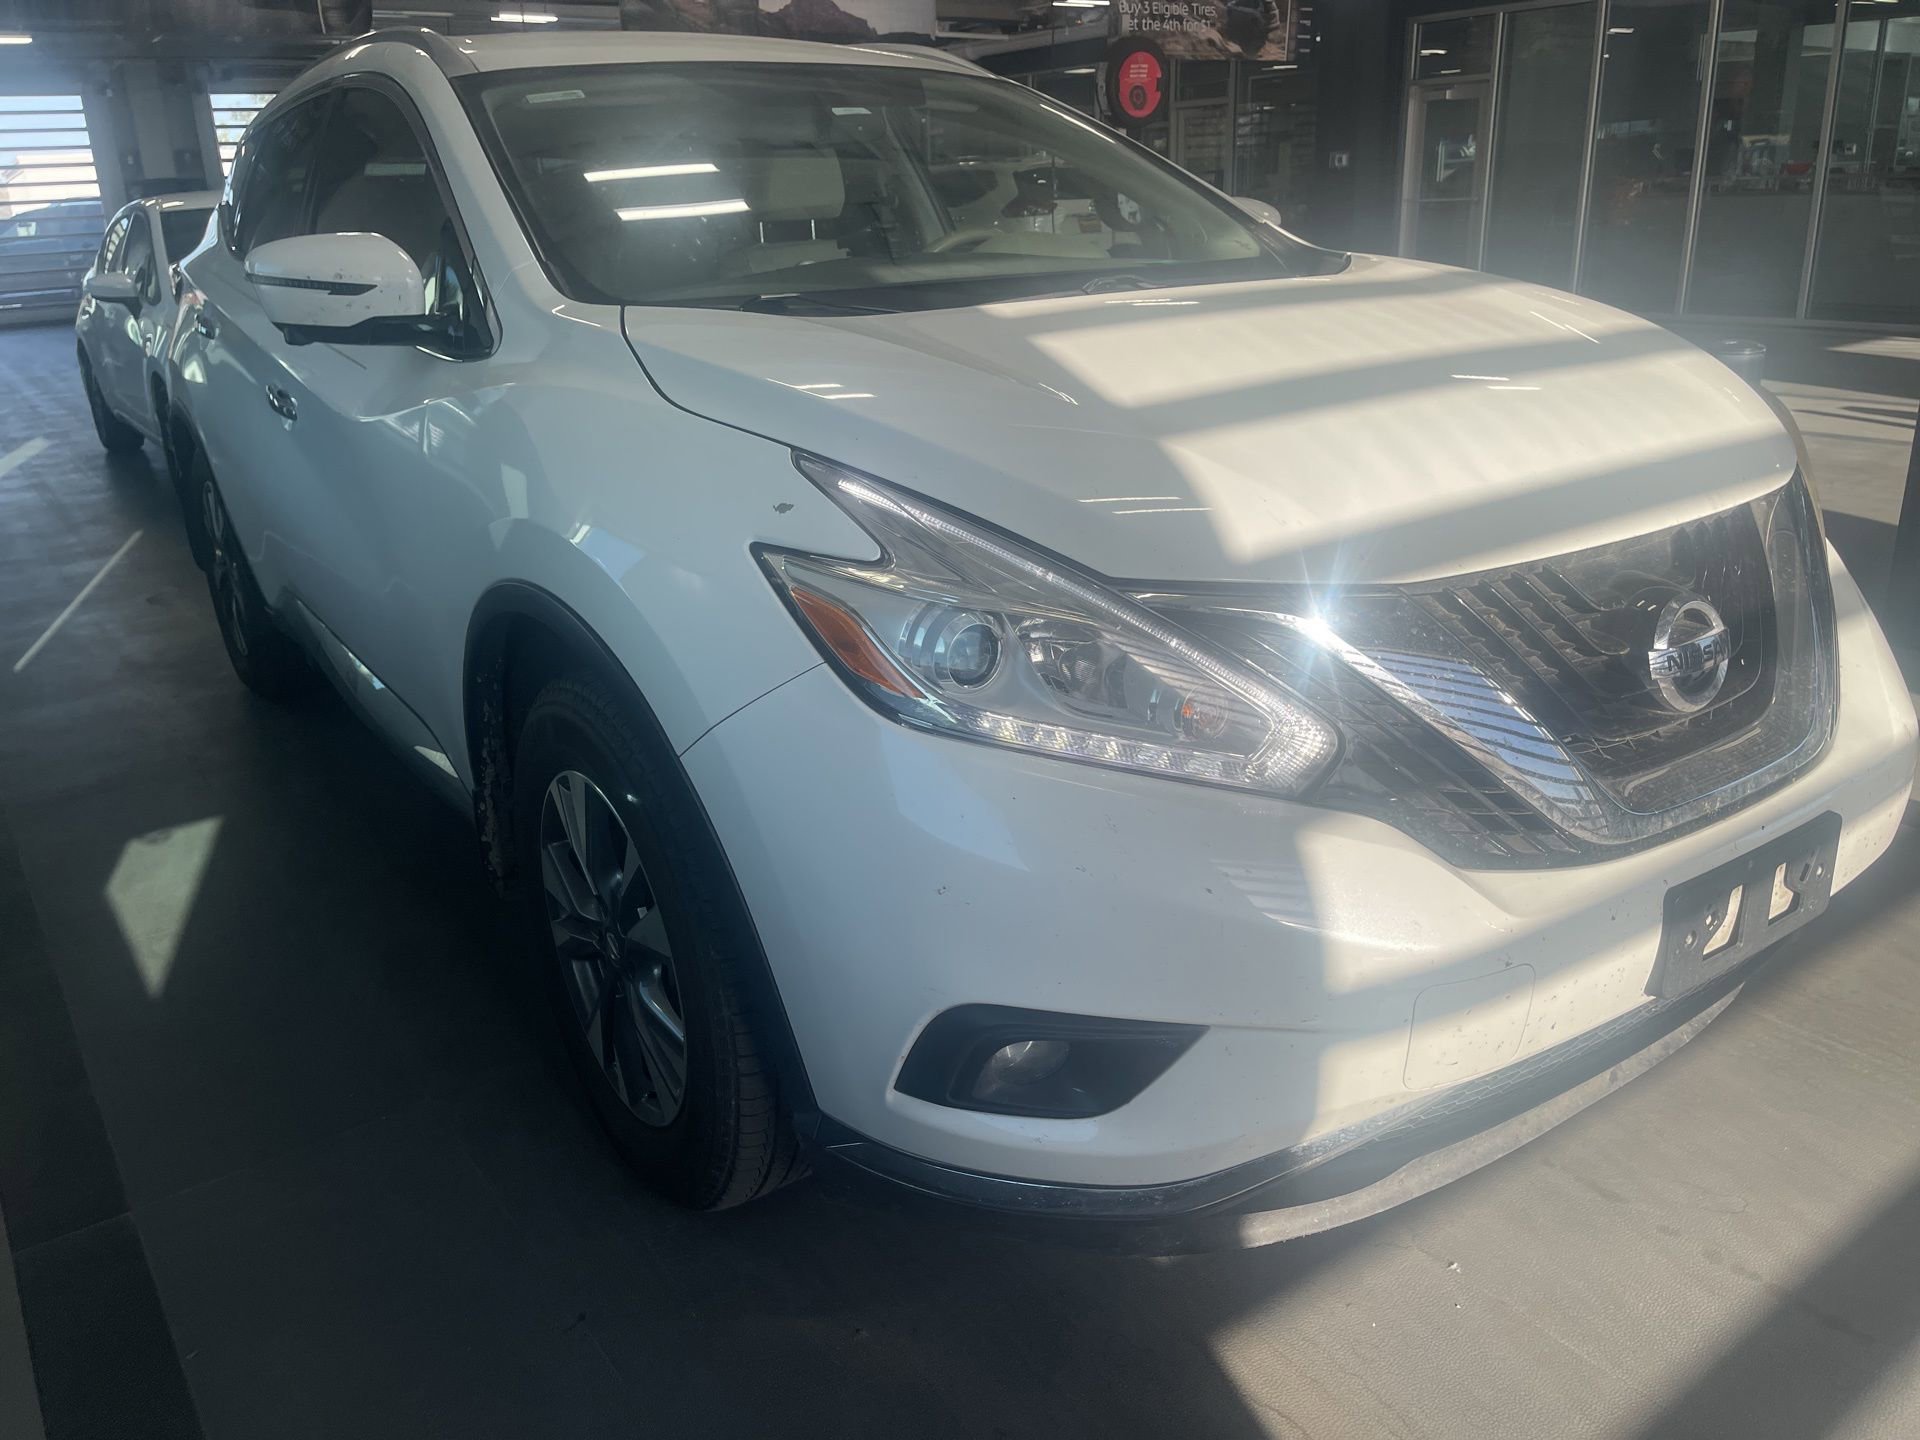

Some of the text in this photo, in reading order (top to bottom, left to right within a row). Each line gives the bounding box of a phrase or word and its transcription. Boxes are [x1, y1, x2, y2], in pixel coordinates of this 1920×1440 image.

[1119, 0, 1141, 17] Buy
[1143, 1, 1150, 14] 3
[1152, 2, 1189, 18] Eligible
[1142, 17, 1161, 31] the
[1162, 18, 1181, 32] 4th
[1183, 18, 1200, 32] for
[1666, 635, 1728, 672] NISA
